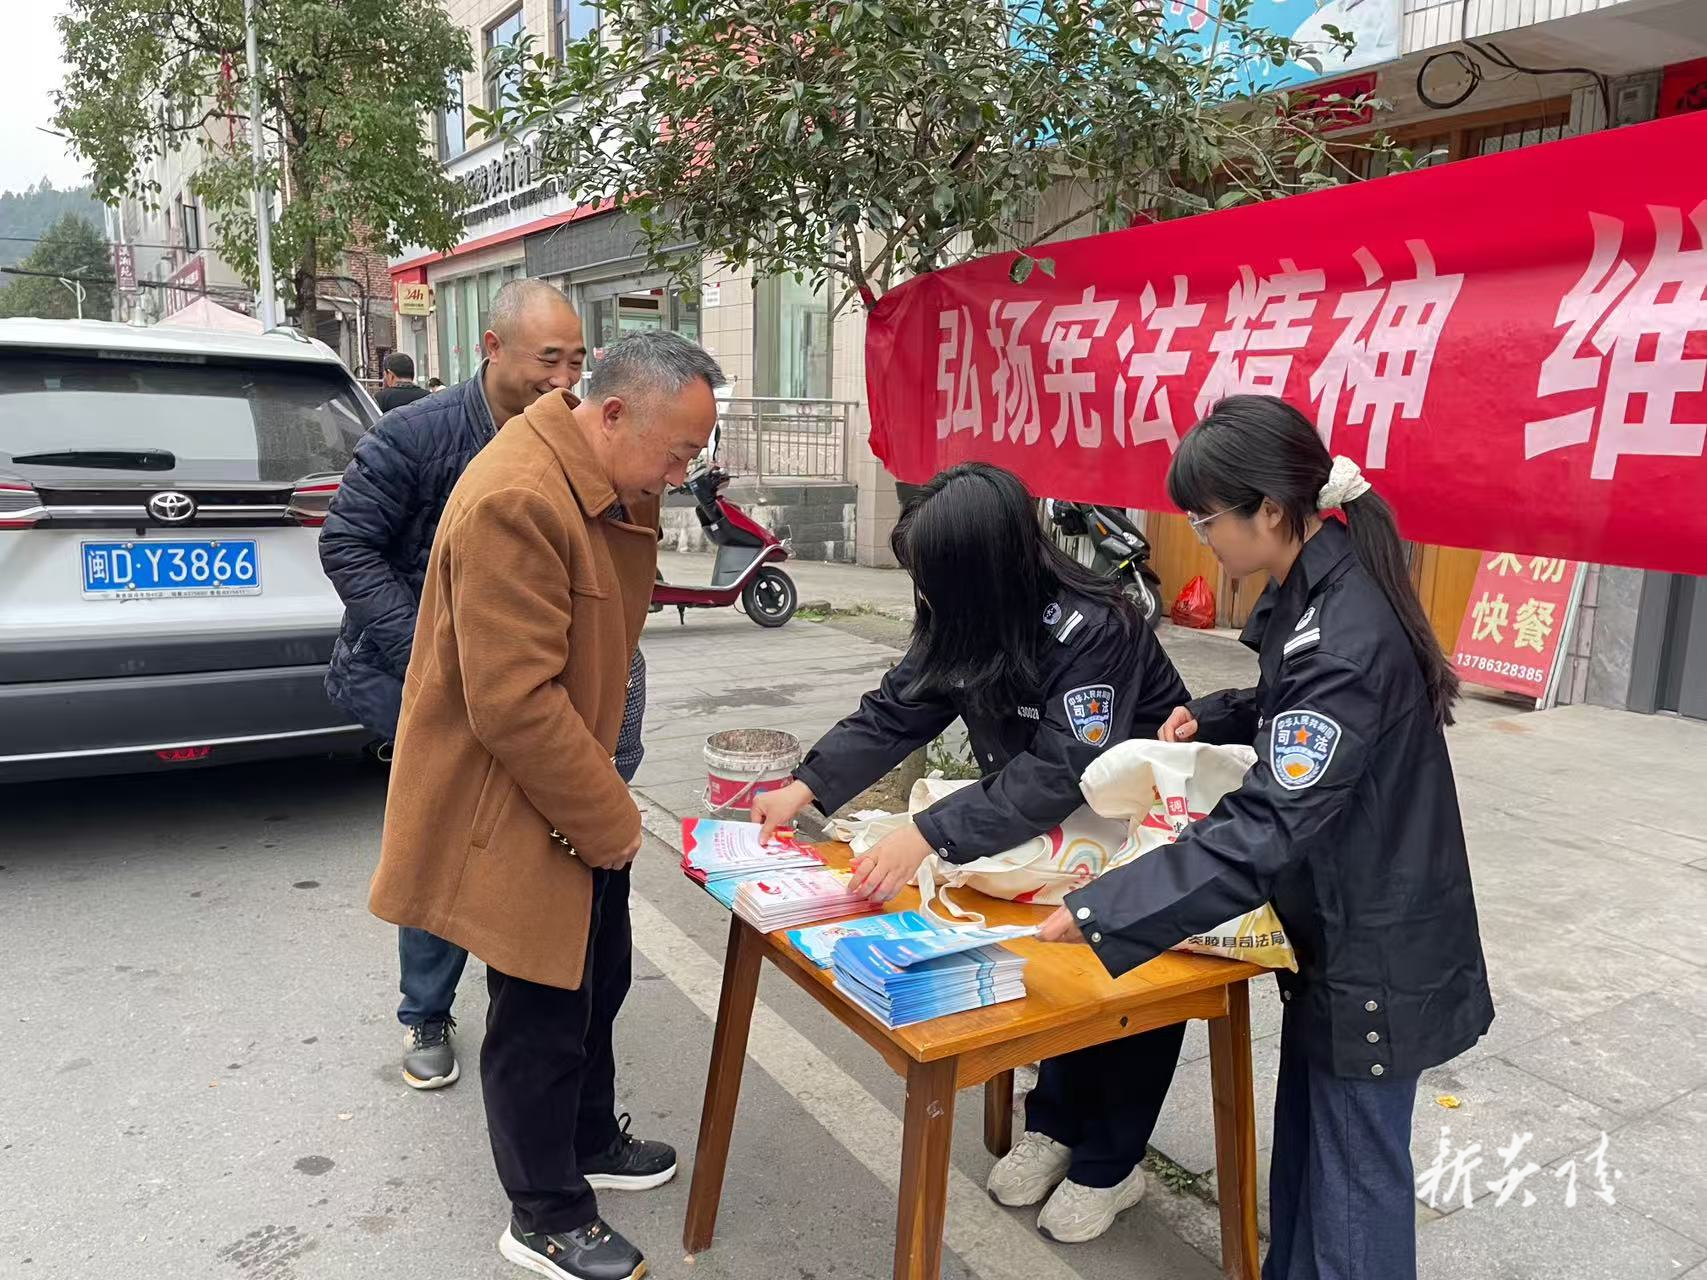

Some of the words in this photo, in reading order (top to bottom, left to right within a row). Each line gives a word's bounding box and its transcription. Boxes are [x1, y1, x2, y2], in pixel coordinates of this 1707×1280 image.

[936, 239, 1464, 469] 弘扬宪法精神
[1525, 203, 1707, 479] 维
[1471, 592, 1556, 653] 快餐
[1456, 652, 1543, 683] 13786328385
